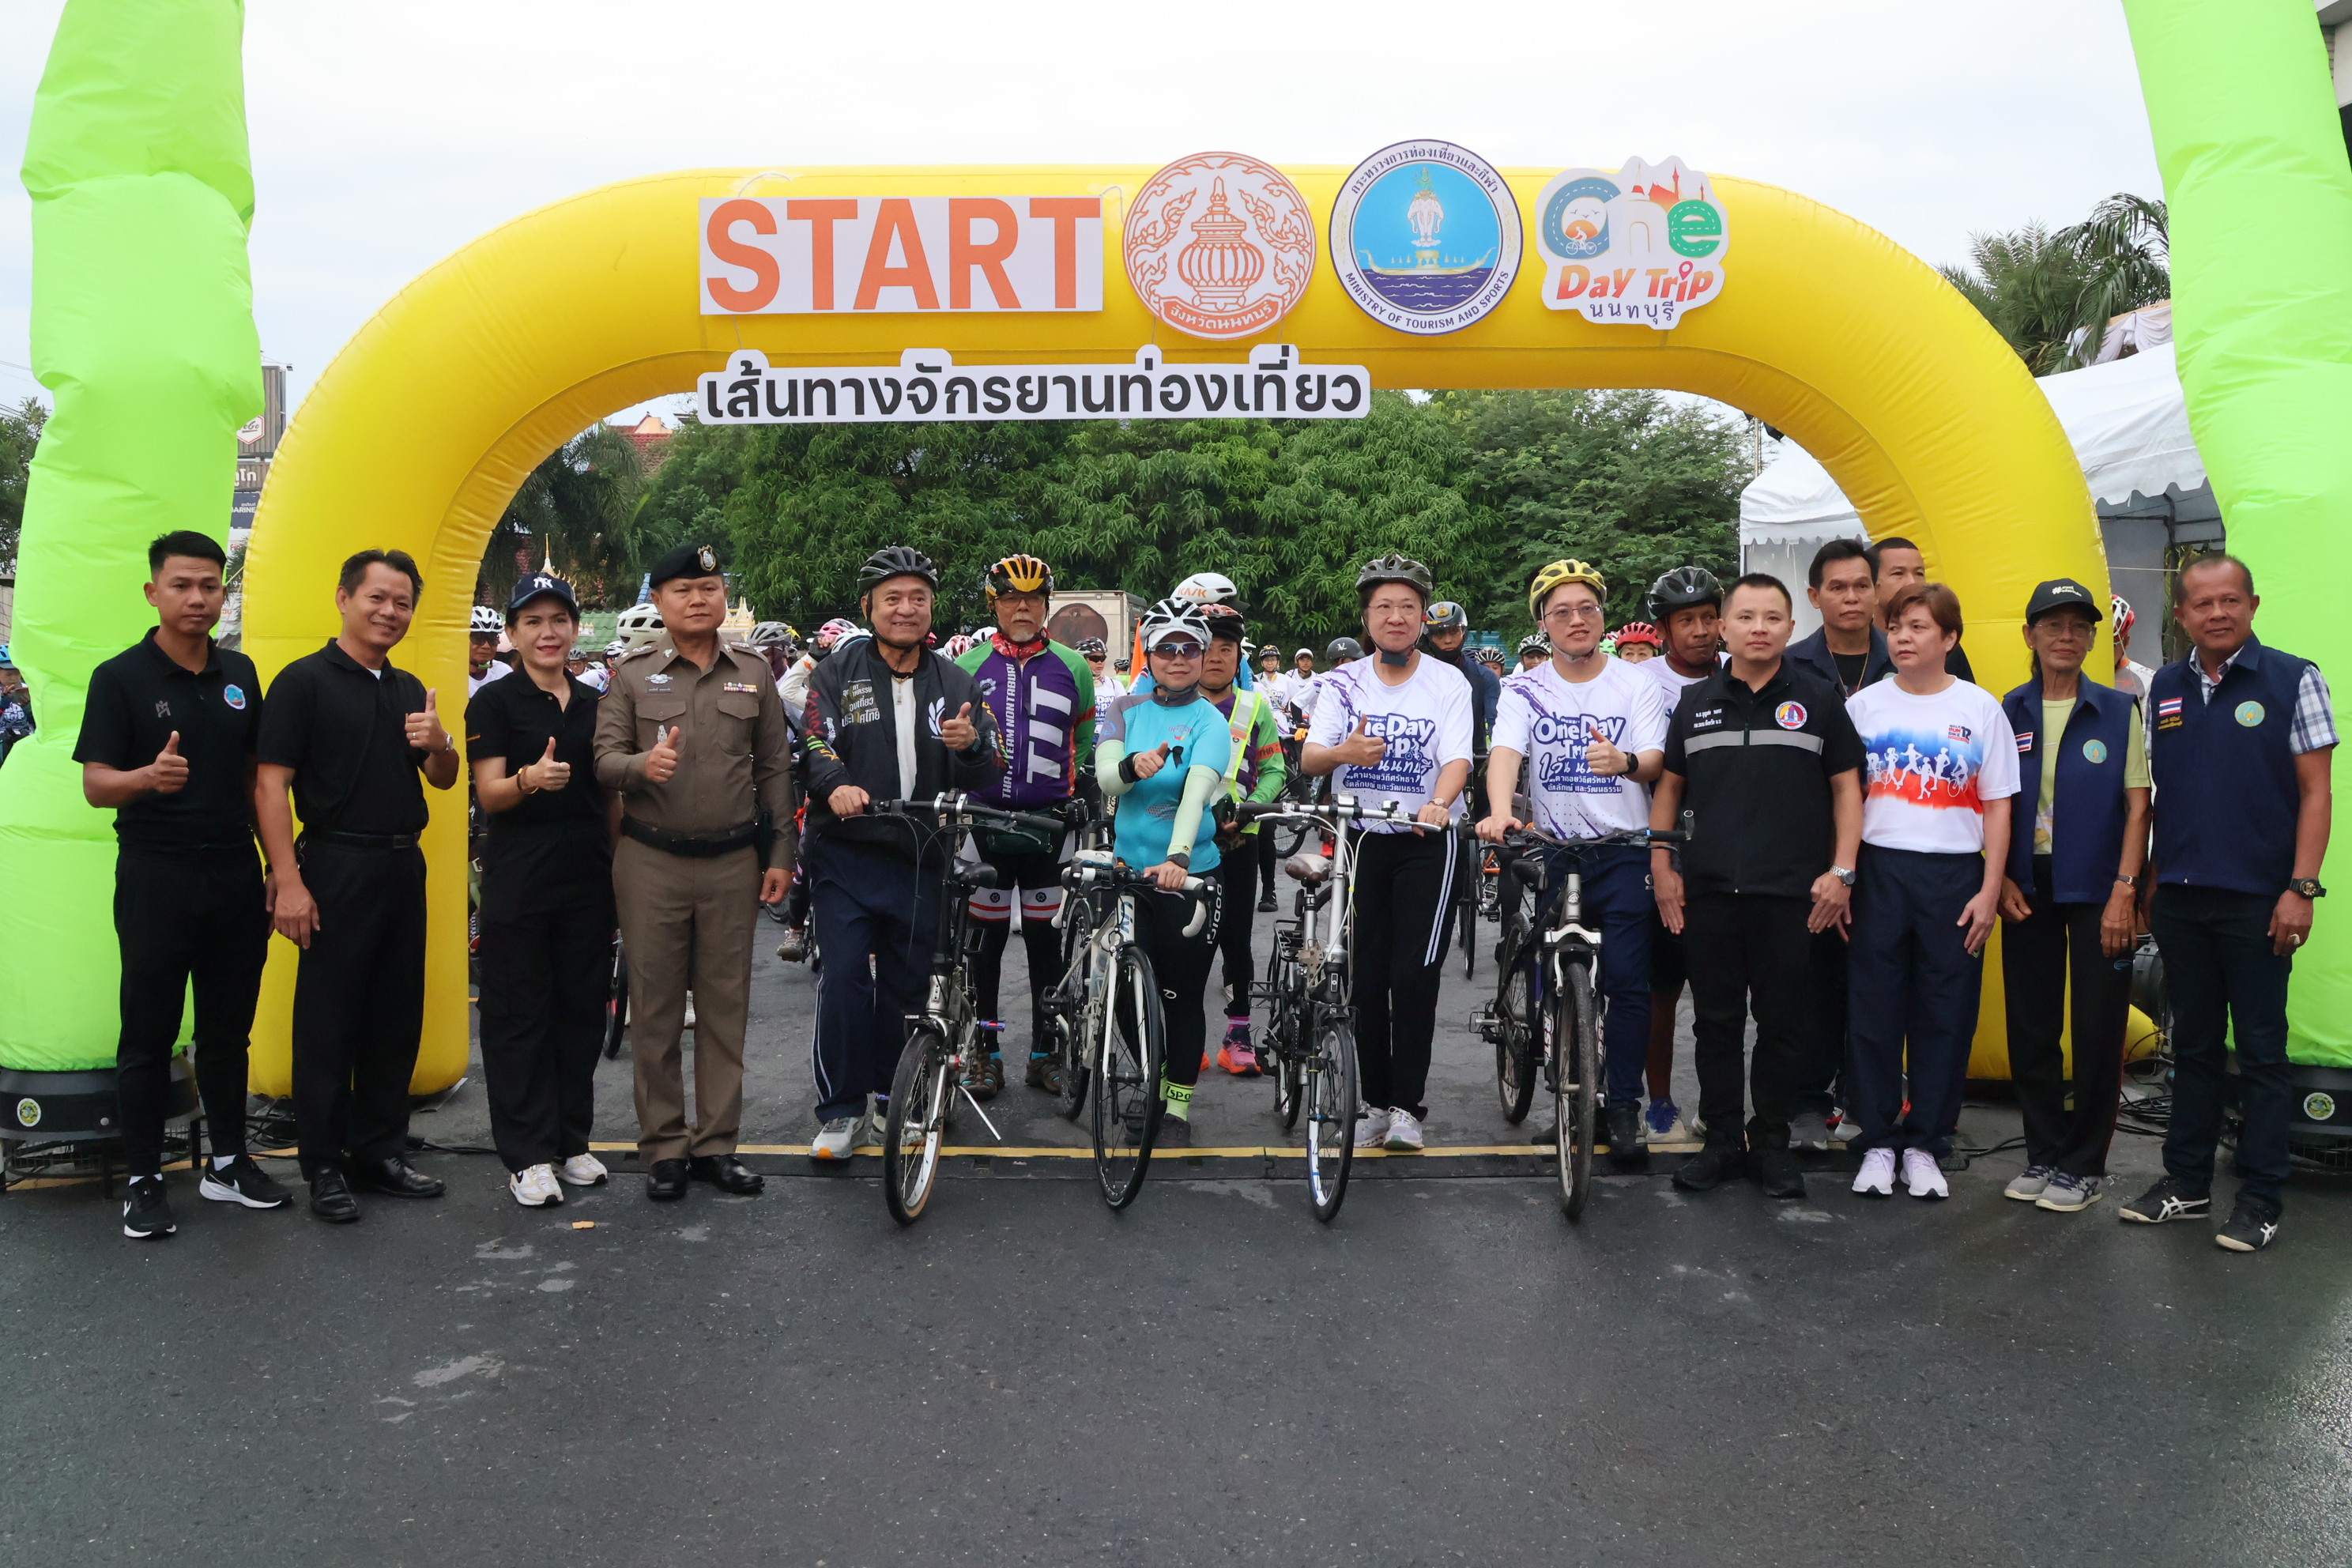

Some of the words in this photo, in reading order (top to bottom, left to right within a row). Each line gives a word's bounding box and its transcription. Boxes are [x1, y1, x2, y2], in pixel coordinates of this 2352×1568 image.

[1351, 144, 1498, 194] กระทรวงการท่องเที่ยวและกีฬา
[706, 197, 1101, 313] START
[1345, 273, 1386, 315] MINISTRY
[1388, 312, 1402, 323] OF
[1406, 318, 1455, 329] TOURISM
[1458, 306, 1479, 323] AND
[1479, 271, 1509, 308] SPORTS
[1556, 264, 1637, 300] Day
[1645, 262, 1714, 302] Trip
[1170, 301, 1272, 330] จังหวัดนนทบุรี
[1589, 300, 1675, 325] นนทบุรี
[706, 345, 1363, 419] เส้นทางจักรยานท่องเที่ยว
[1178, 587, 1207, 598] KASK
[1006, 662, 1016, 728] NONTABURI
[1006, 729, 1015, 760] TEAM
[1544, 1015, 1553, 1060] RST
